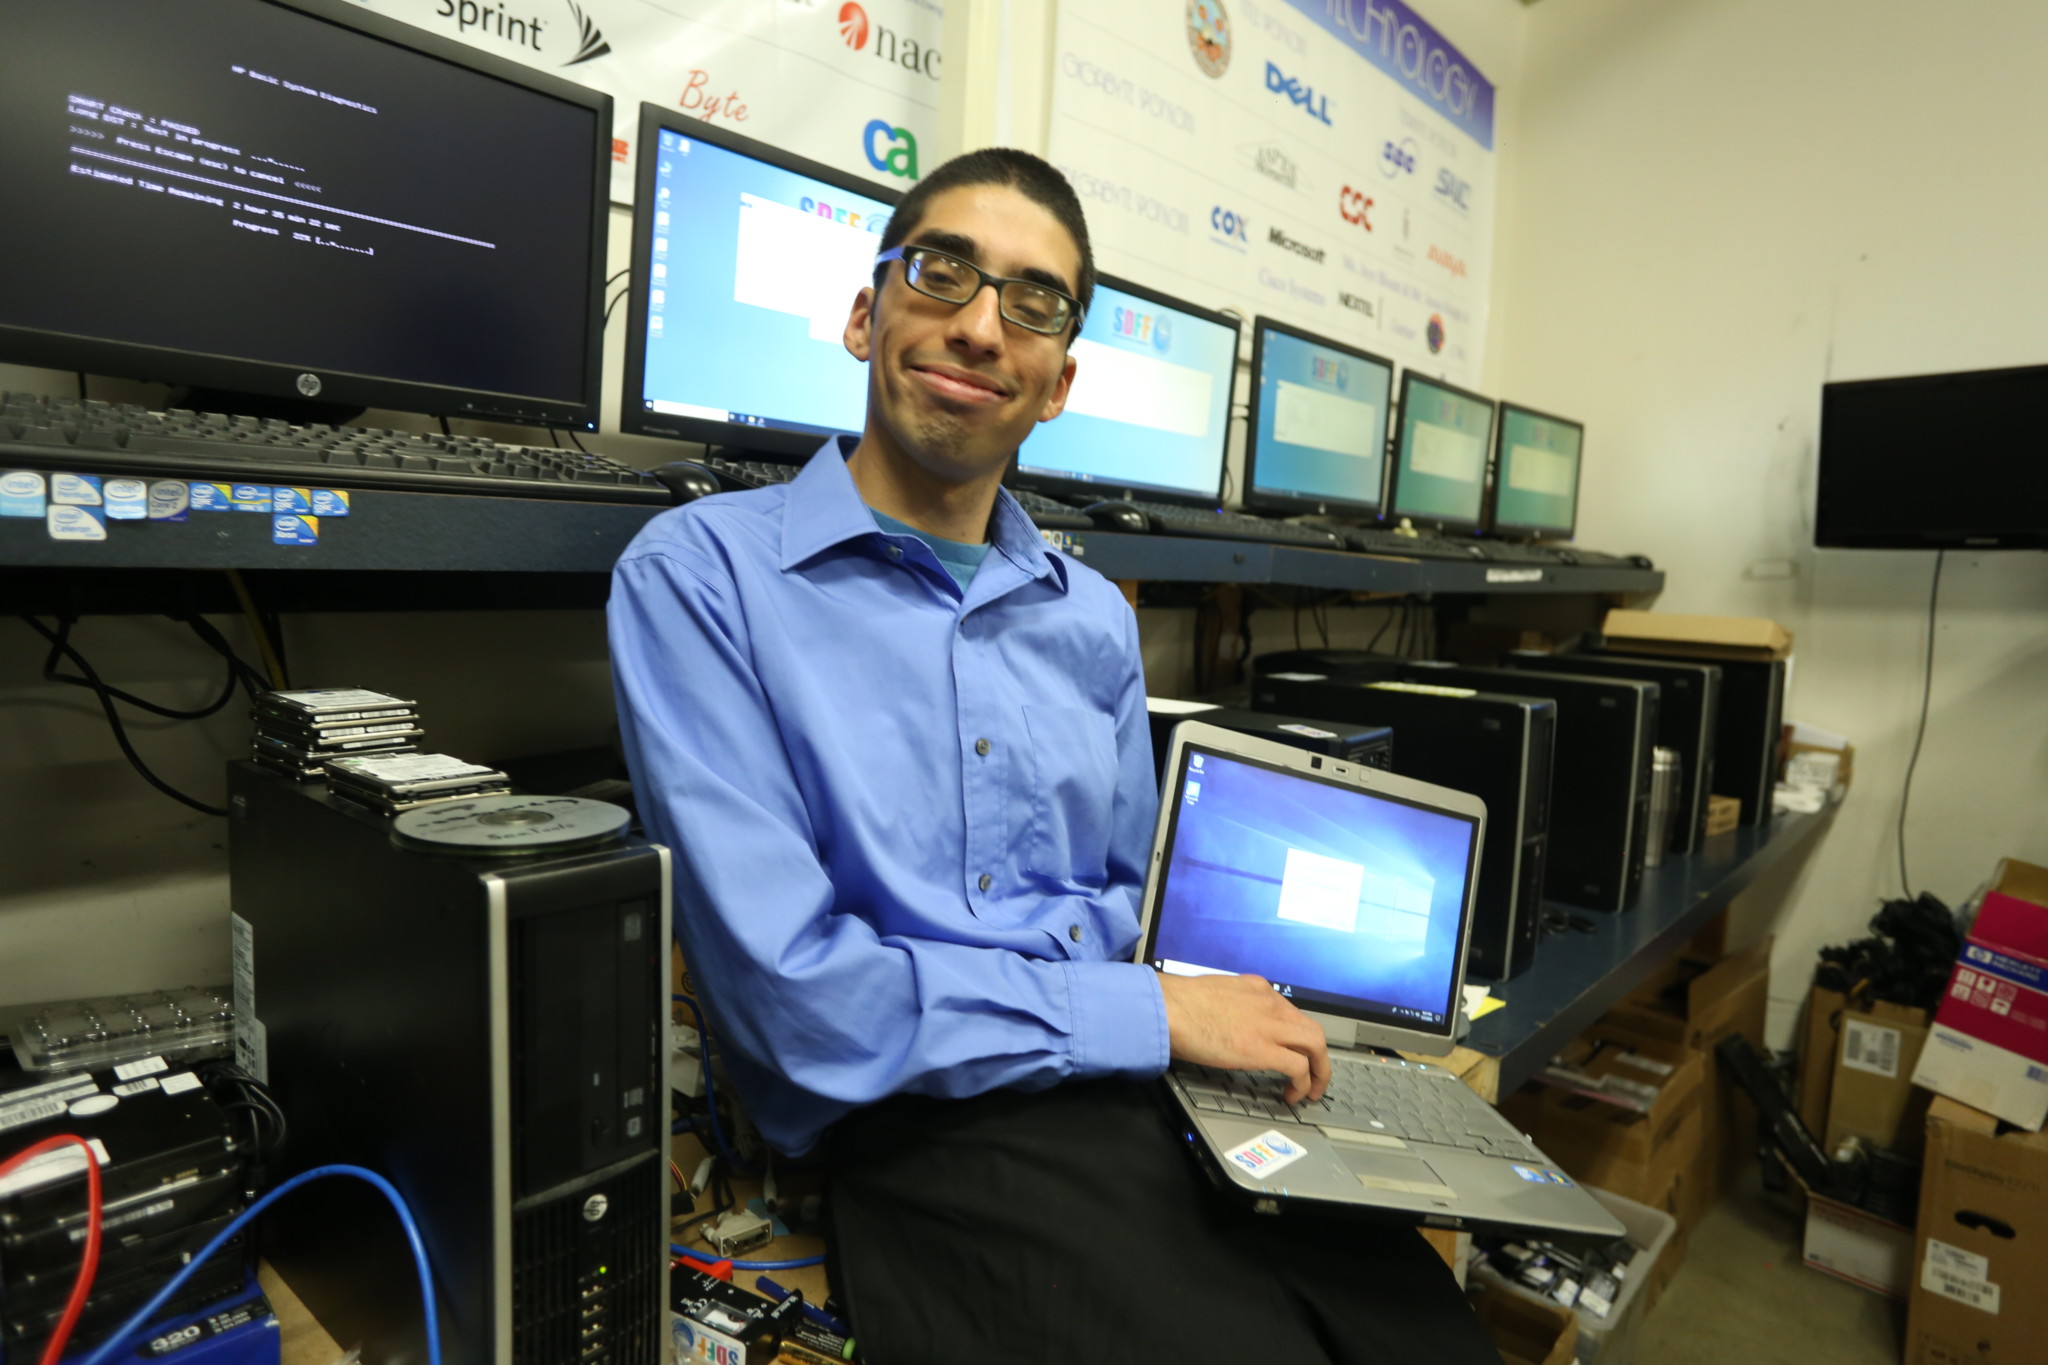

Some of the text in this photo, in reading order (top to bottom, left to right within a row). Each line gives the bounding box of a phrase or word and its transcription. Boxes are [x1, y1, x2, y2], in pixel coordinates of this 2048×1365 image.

[679, 69, 750, 122] Byte
[1265, 60, 1333, 127] DELL
[1211, 205, 1249, 243] COX
[1267, 226, 1326, 265] Microsoft
